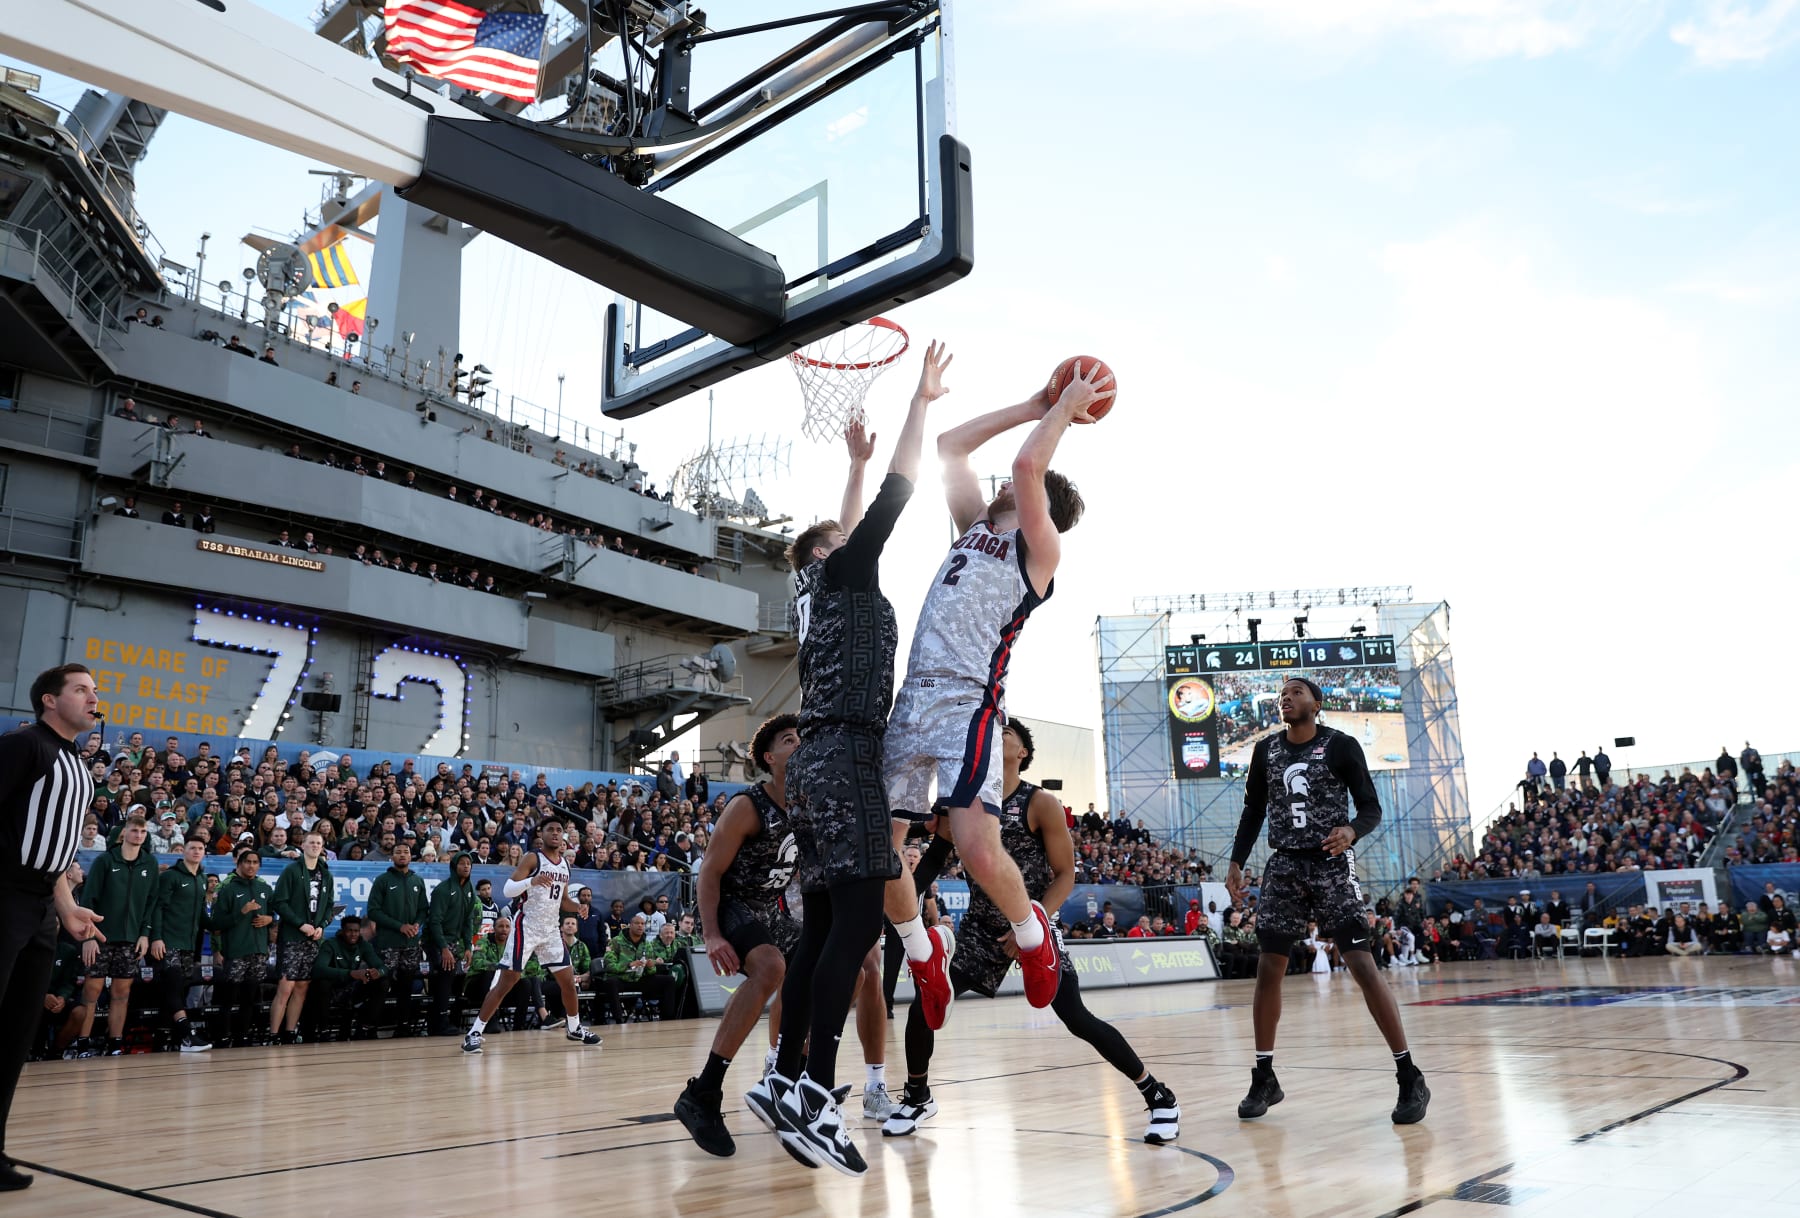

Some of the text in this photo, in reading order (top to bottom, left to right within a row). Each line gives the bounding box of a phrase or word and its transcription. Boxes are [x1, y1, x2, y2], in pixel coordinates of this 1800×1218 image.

[202, 540, 323, 570] USS ABRAHAM LINCOLN
[942, 554, 968, 586] 2
[85, 637, 229, 679] BEWARE OF
[1235, 651, 1255, 666] 24
[1270, 647, 1298, 659] 7:16
[1308, 648, 1327, 661] 18
[138, 675, 212, 706] BLAST
[96, 700, 229, 737] ROPELLERS
[1291, 802, 1307, 829] 5
[549, 883, 561, 899] 13
[760, 867, 794, 890] 25
[1151, 950, 1205, 969] PRATERS
